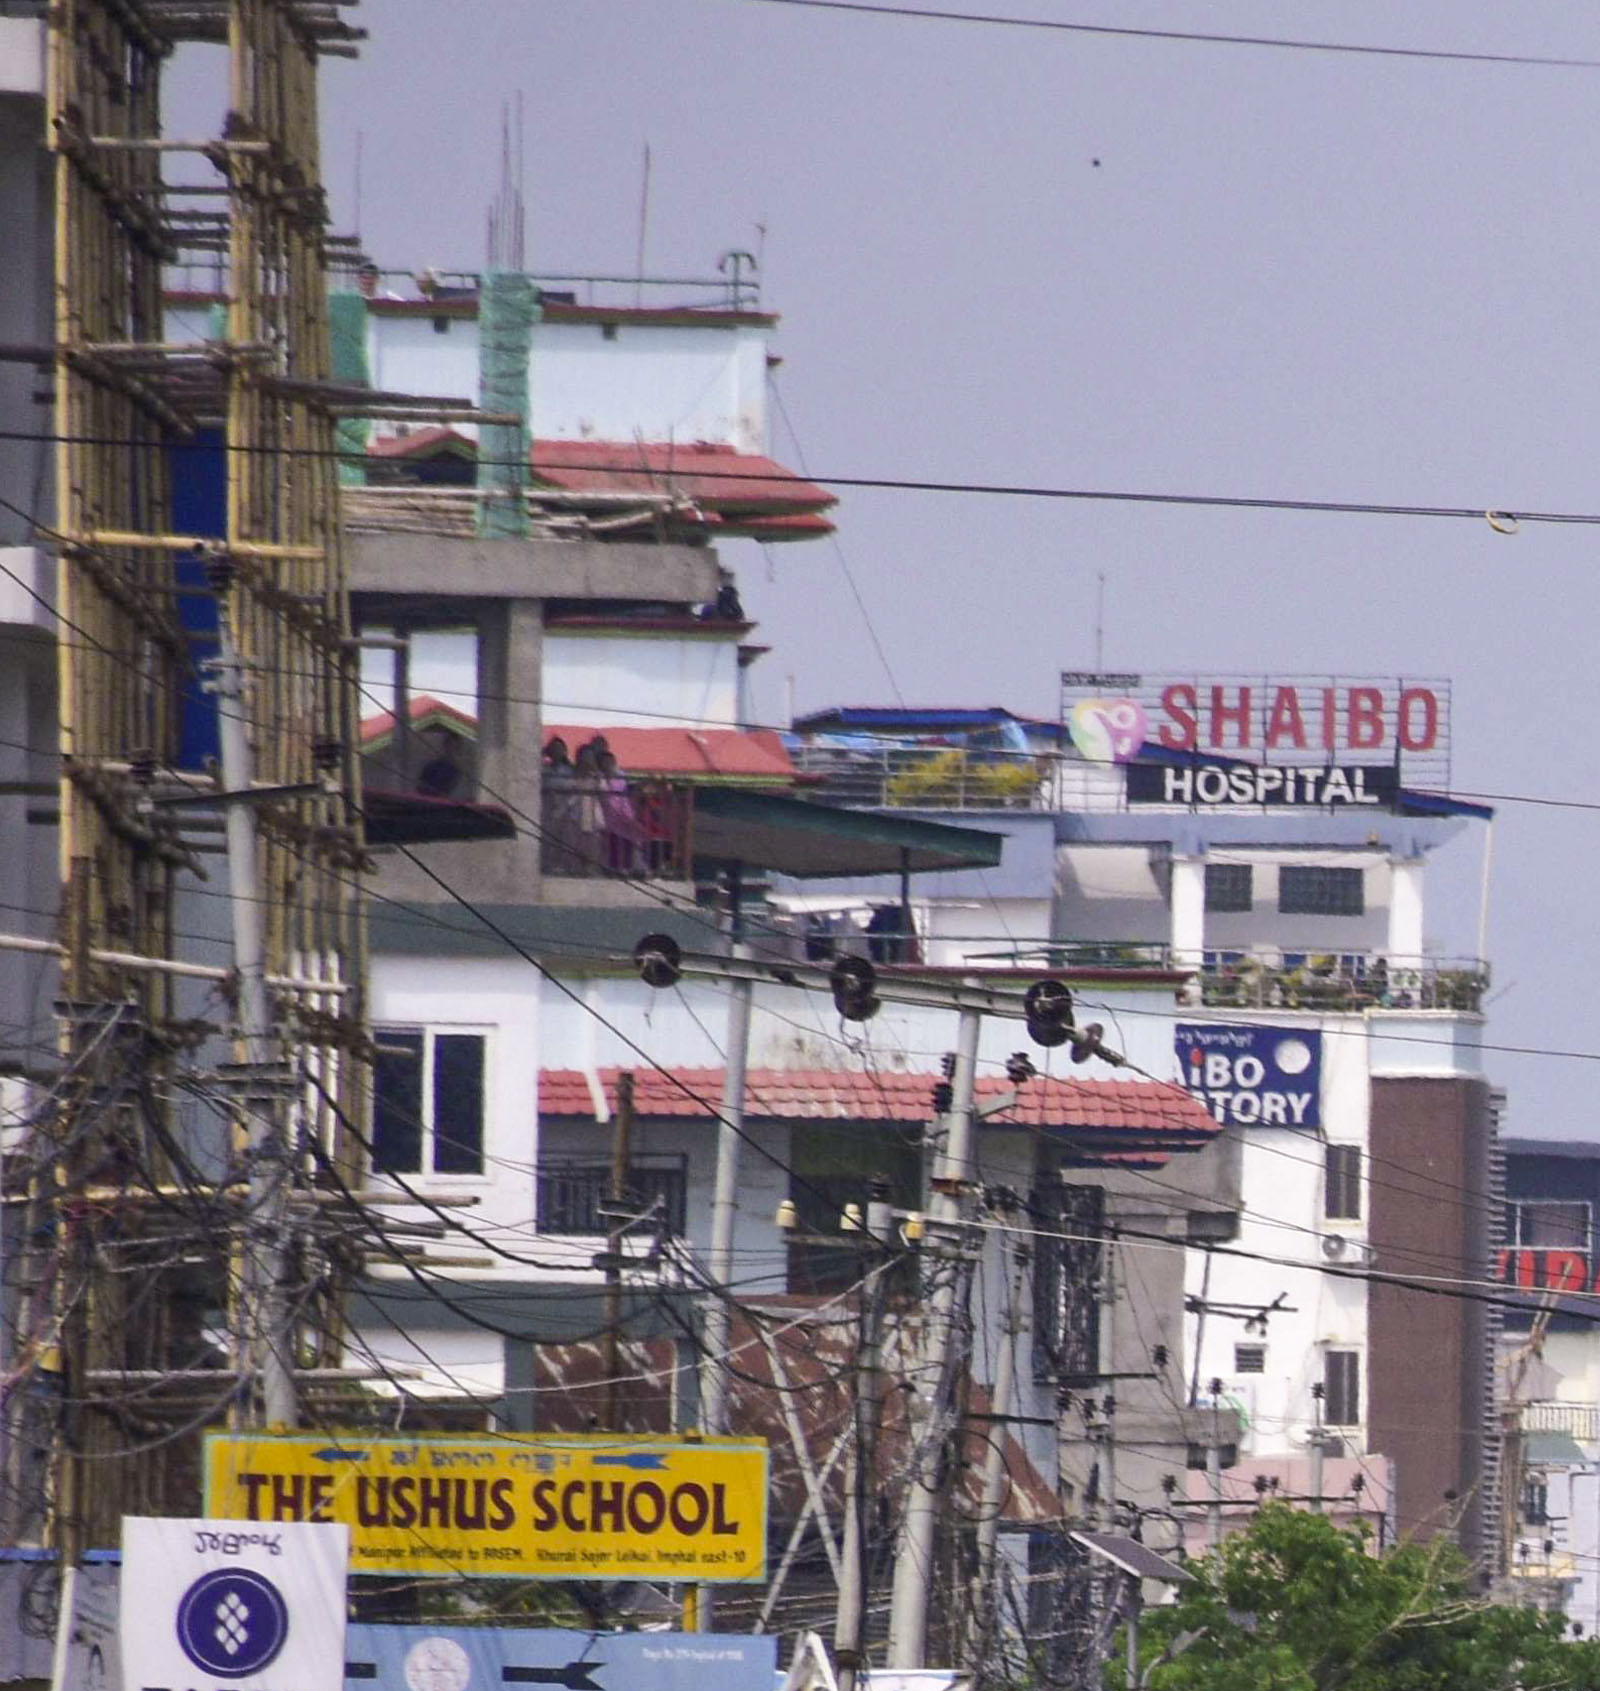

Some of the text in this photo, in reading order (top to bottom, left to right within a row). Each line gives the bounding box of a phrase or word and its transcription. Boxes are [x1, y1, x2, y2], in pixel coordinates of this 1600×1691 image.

[1158, 684, 1438, 752] SHAIBO
[1164, 765, 1380, 804] HOSPITAL
[237, 1473, 739, 1536] THE USHUS SCHOOL
